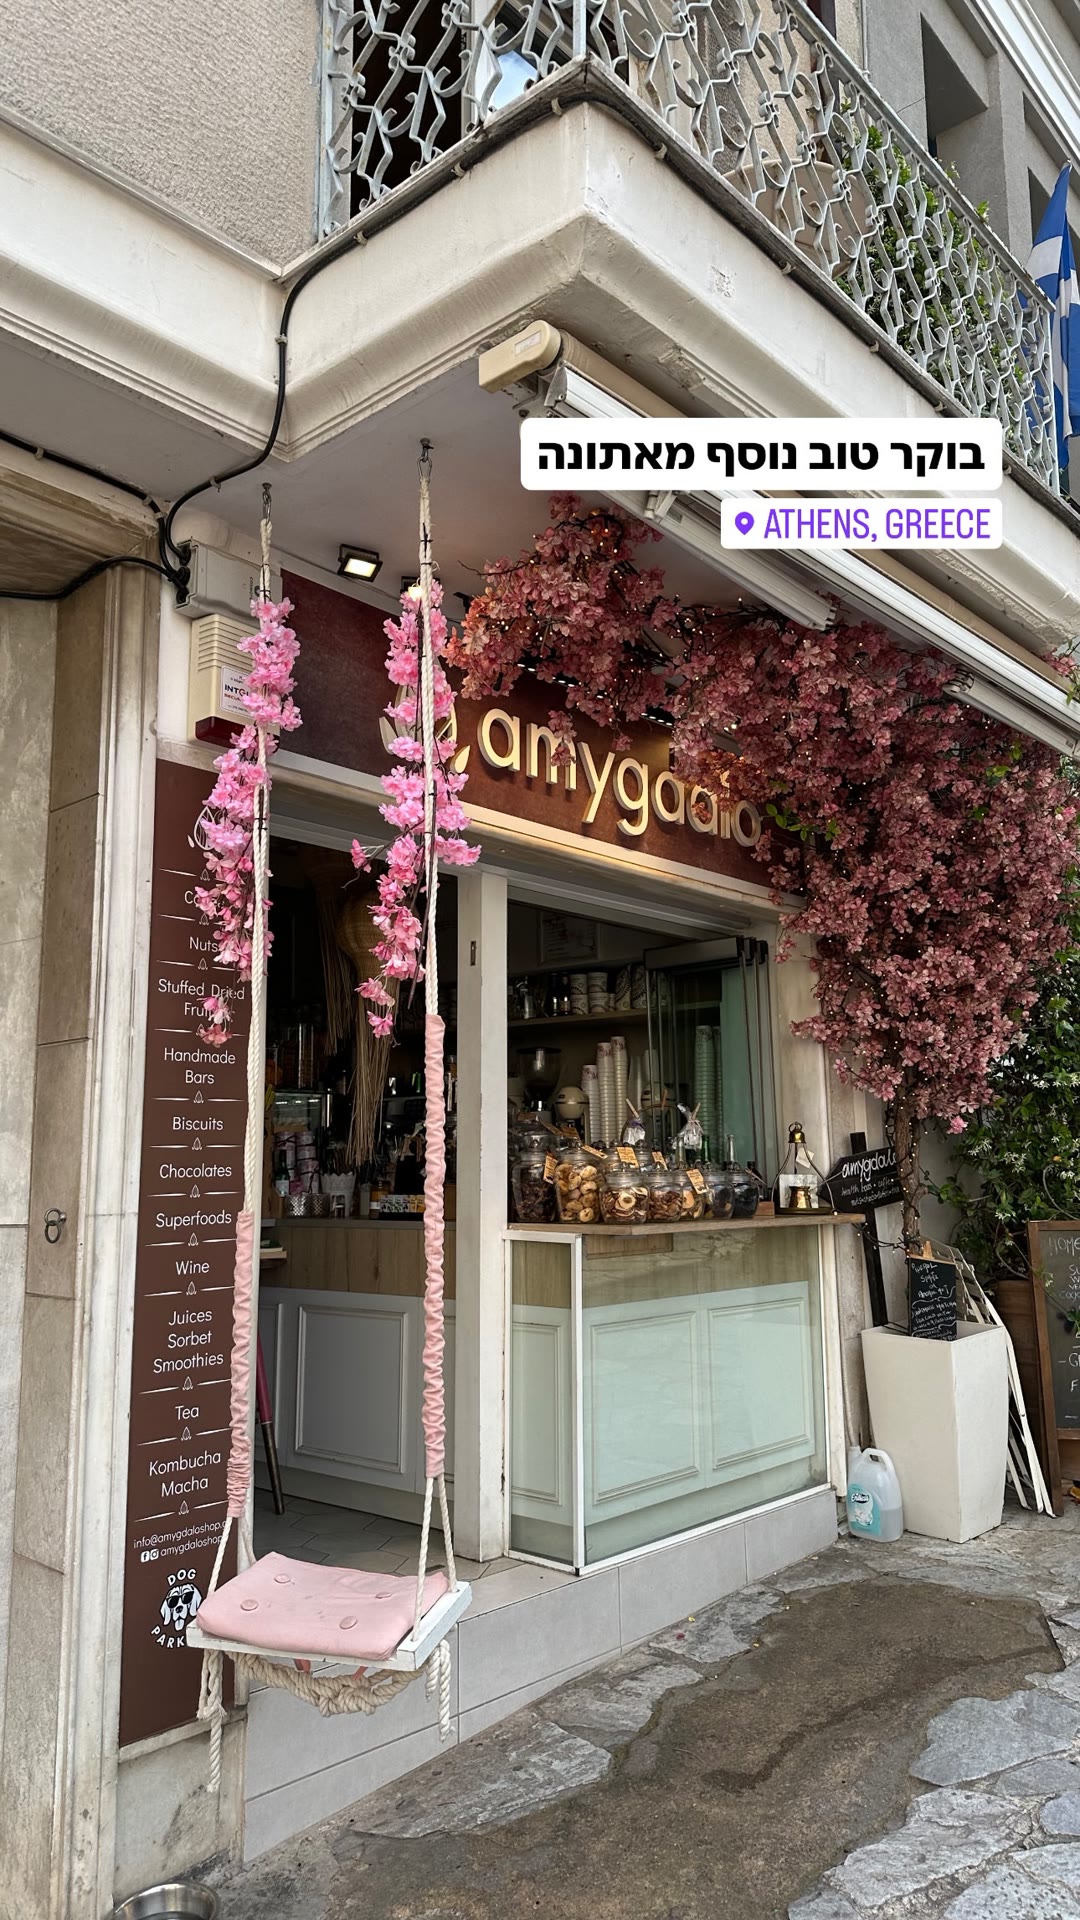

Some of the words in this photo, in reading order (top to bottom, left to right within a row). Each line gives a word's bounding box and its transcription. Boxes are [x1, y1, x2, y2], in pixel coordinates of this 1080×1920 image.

[190, 936, 218, 953] Nuts
[158, 978, 205, 996] Stuffed
[211, 984, 245, 1000] Dried
[164, 1047, 236, 1065] Handmade
[185, 1070, 215, 1085] Bars
[172, 1116, 224, 1131] Biscuits
[159, 1163, 232, 1179] Chocolates
[155, 1210, 232, 1230] Superfoods
[175, 1260, 210, 1276] Wine
[168, 1309, 213, 1326] Juices
[167, 1330, 212, 1349] Sorbet
[153, 1350, 224, 1374] Smoothies
[175, 1405, 200, 1420] Tea
[149, 1450, 221, 1477] Kombucha
[161, 1476, 209, 1498] Macha
[133, 1520, 226, 1549] info@amygdaloshop.g
[167, 1568, 197, 1587] DOG
[151, 1624, 185, 1649] PARK
